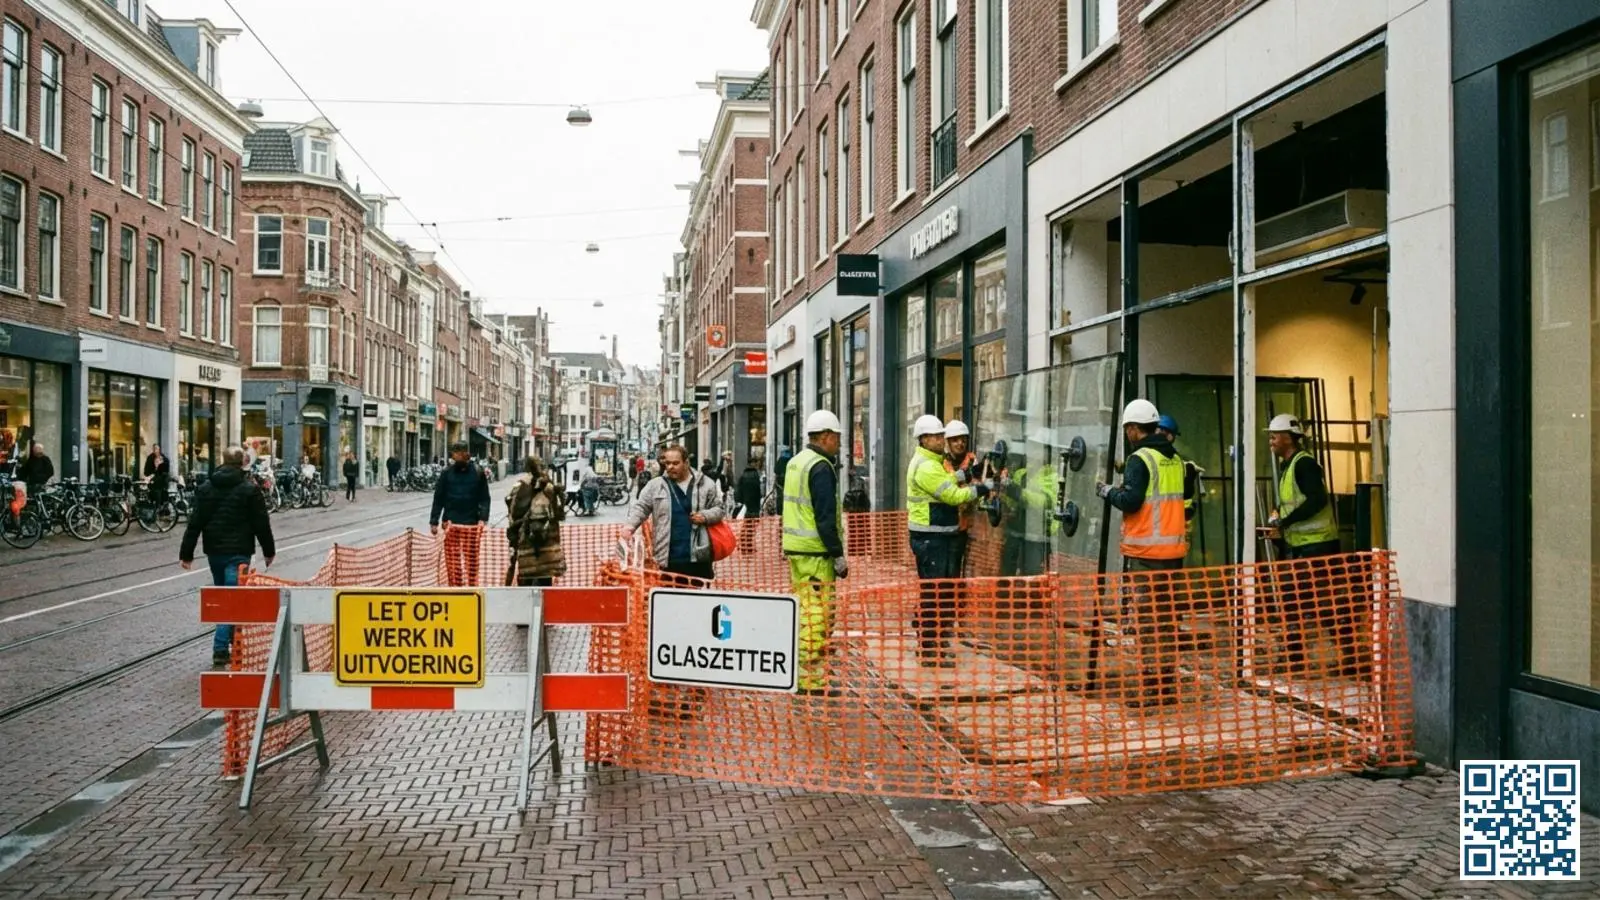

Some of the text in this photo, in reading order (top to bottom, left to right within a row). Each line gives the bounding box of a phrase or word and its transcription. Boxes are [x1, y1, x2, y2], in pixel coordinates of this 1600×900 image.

[368, 602, 449, 621] LET OP!
[711, 604, 732, 641] G
[364, 628, 453, 647] WERK IN
[344, 654, 474, 674] UITVOERING
[657, 643, 787, 674] GLASZETTER
